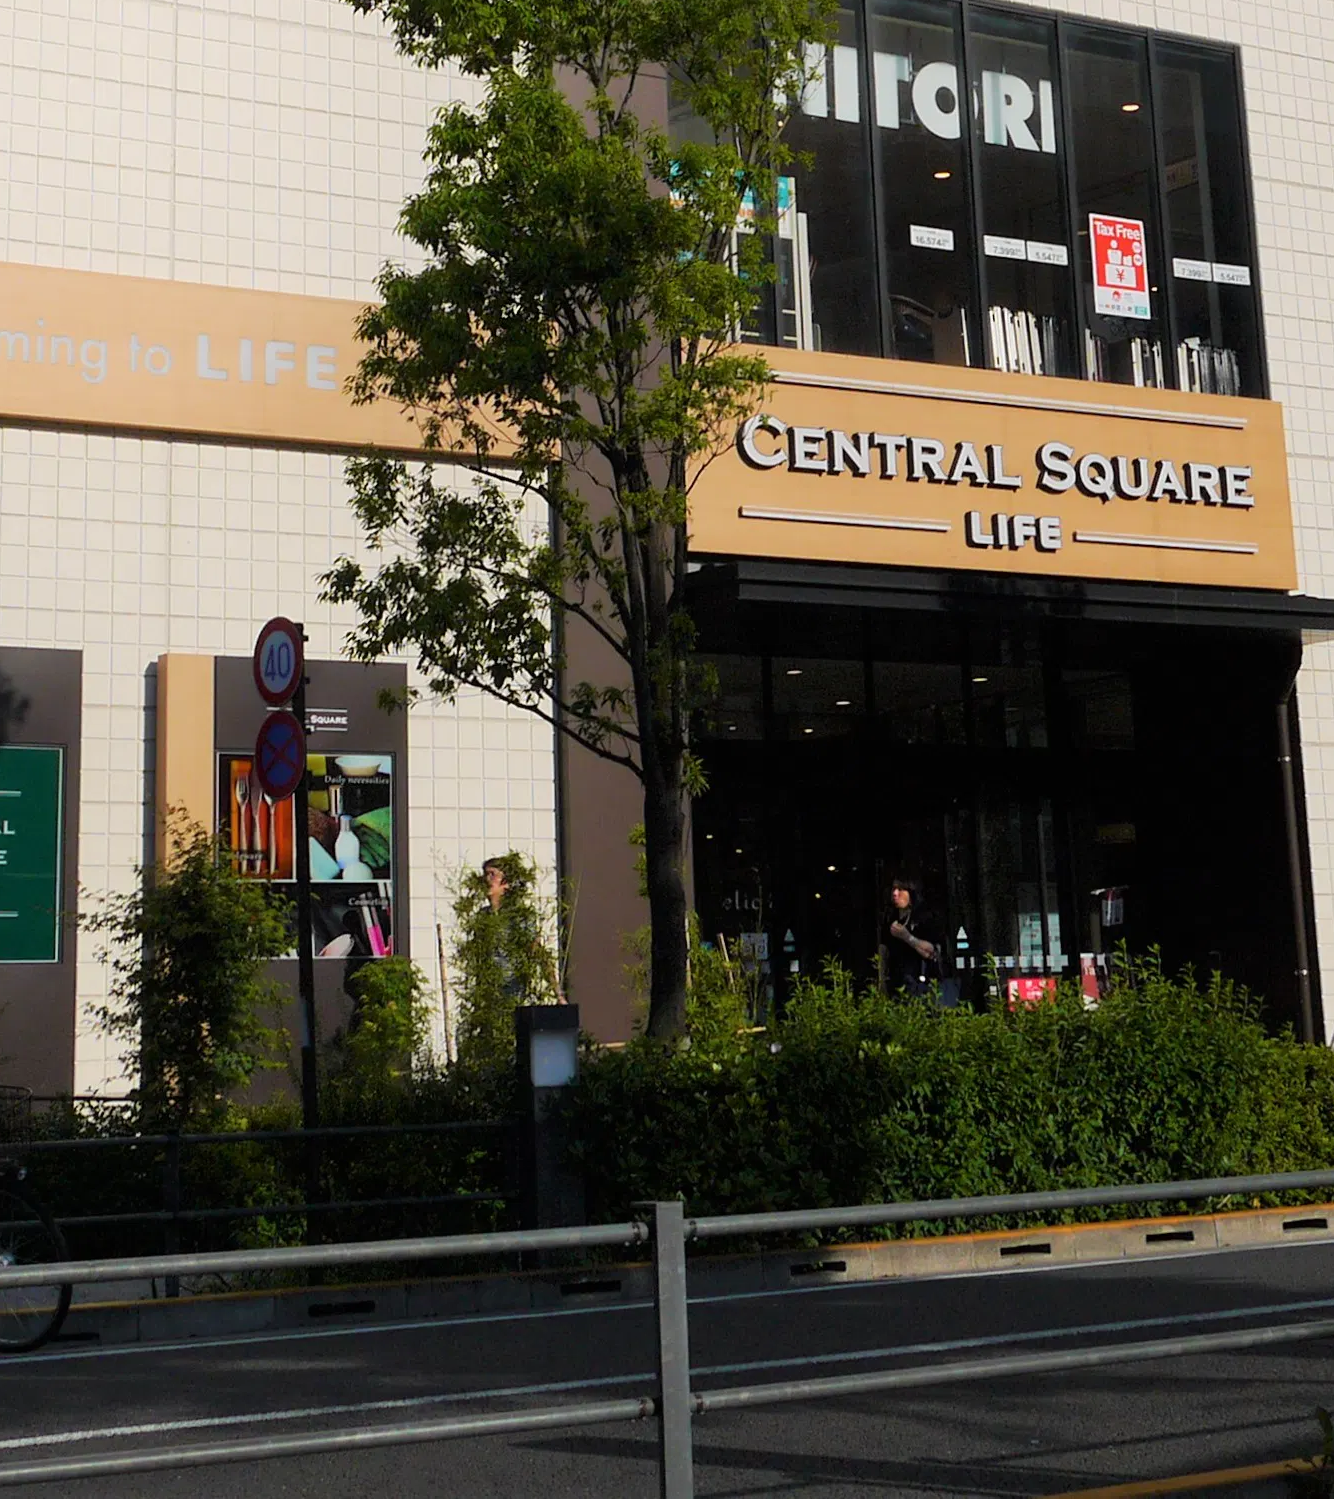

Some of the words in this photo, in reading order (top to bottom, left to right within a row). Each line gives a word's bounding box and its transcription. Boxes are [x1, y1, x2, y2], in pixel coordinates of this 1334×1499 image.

[1094, 221, 1115, 237] Tax
[1115, 224, 1142, 240] Free
[129, 333, 173, 376] to
[197, 334, 338, 391] LIFE
[740, 414, 1022, 489] CENTRAL
[1038, 441, 1256, 508] SQUARE
[966, 510, 1063, 551] LIFE
[264, 642, 290, 681] 40
[310, 714, 348, 725] SQUARE
[324, 774, 346, 786] Daily
